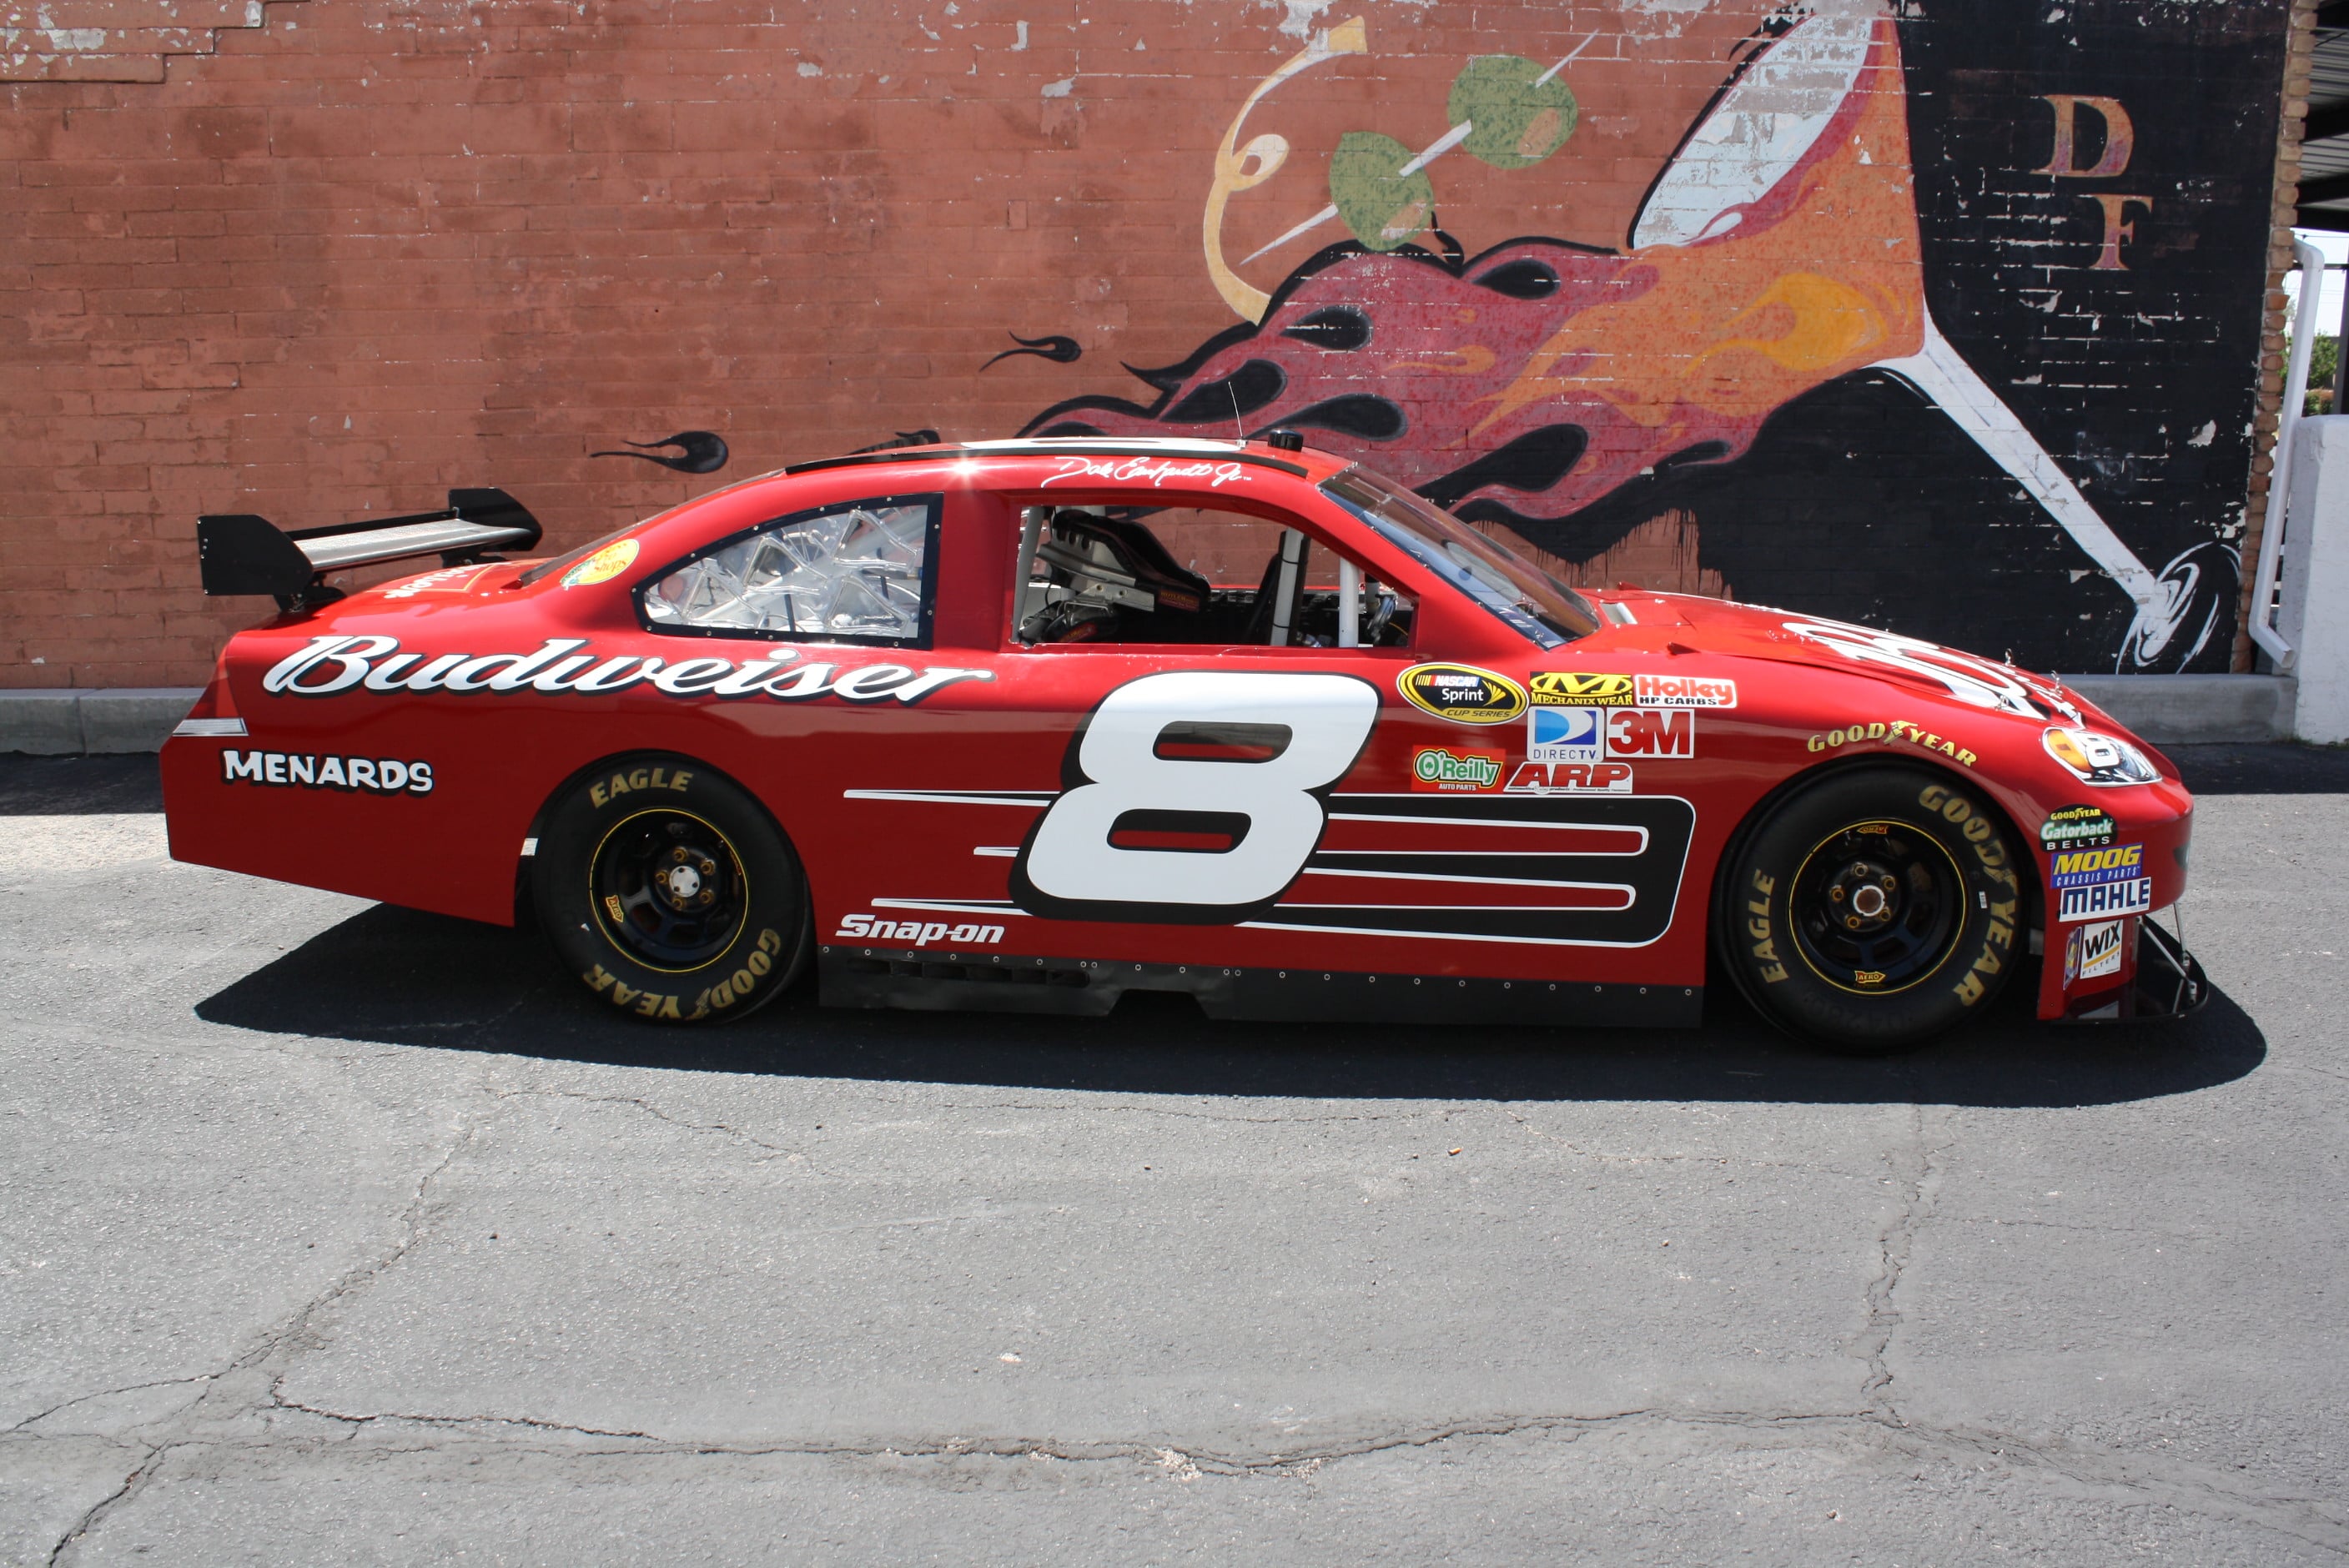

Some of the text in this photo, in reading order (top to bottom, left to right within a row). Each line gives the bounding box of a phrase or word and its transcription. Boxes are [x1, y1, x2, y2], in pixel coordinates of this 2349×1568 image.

[2030, 94, 2134, 178] D
[2090, 193, 2153, 270] F
[263, 635, 996, 707] Budweiser
[1434, 675, 1480, 687] NASCAR
[1441, 688, 1484, 704] Sprint
[1531, 692, 1634, 706] MECHANIX WEAR
[1638, 676, 1734, 706] Holley
[1639, 696, 1718, 706] HP CARBS
[1471, 710, 1512, 718] SERIES
[1607, 711, 1691, 755] 3M
[224, 749, 433, 793] MENARDS
[1417, 751, 1498, 785] O'Reilly
[1533, 749, 1597, 760] DIRECTV
[590, 767, 694, 808] EAGLE
[1026, 671, 1380, 906] 8
[1509, 763, 1632, 788] ARP
[2040, 818, 2114, 841] Gatorback
[2046, 836, 2110, 851] BELTS
[2054, 844, 2143, 876] MOOG
[2056, 867, 2137, 887] CHASSIS PARTS
[2061, 878, 2150, 915] MAHLE
[835, 913, 1005, 947] Snap-on
[1748, 869, 1789, 983] EAGLE
[2085, 921, 2120, 960] WIX
